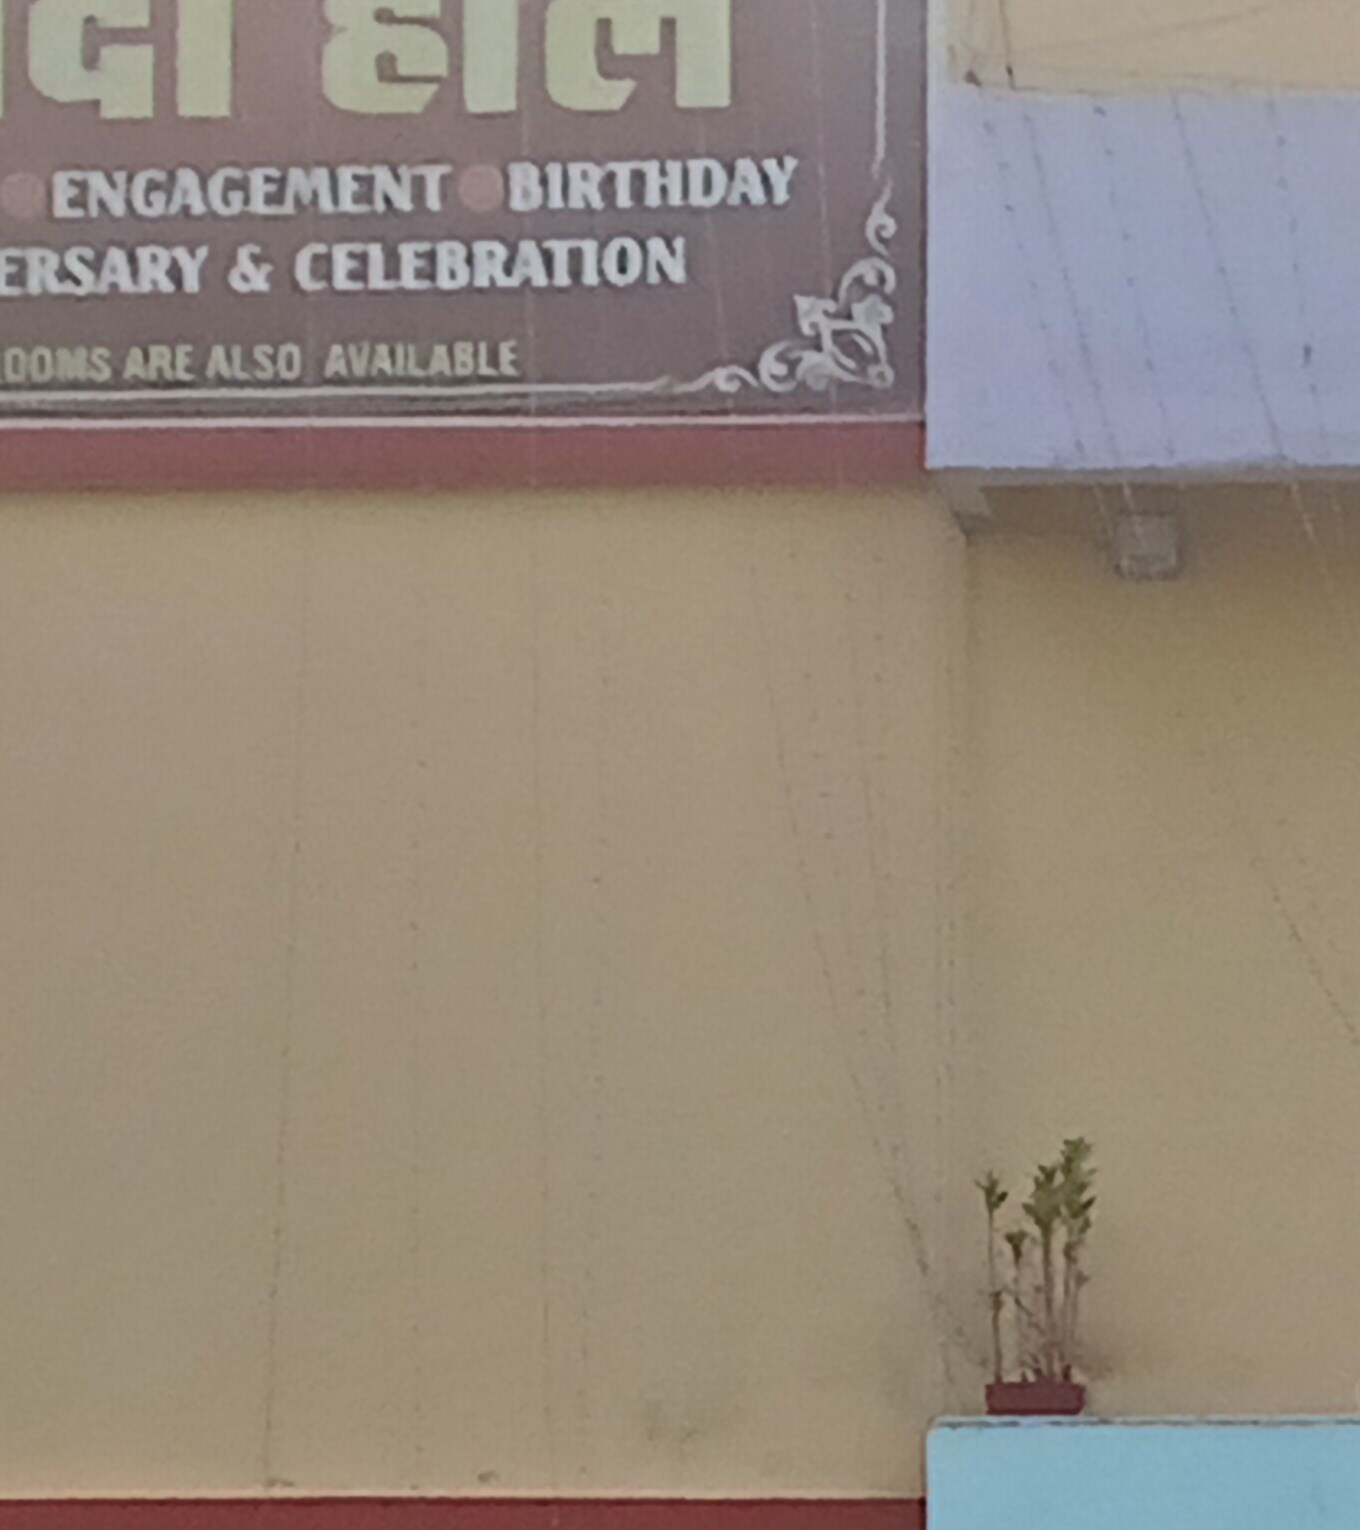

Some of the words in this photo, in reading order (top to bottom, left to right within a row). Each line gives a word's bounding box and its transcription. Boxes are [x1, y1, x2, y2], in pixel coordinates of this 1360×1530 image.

[50, 163, 452, 219] ENGAGEMENT
[506, 154, 798, 211] BIRTHDAY
[227, 243, 273, 293] &
[294, 235, 687, 291] CELEBRATION
[122, 344, 196, 382] ARE
[205, 342, 303, 381] ALSO
[324, 338, 520, 379] AVAILABLE
